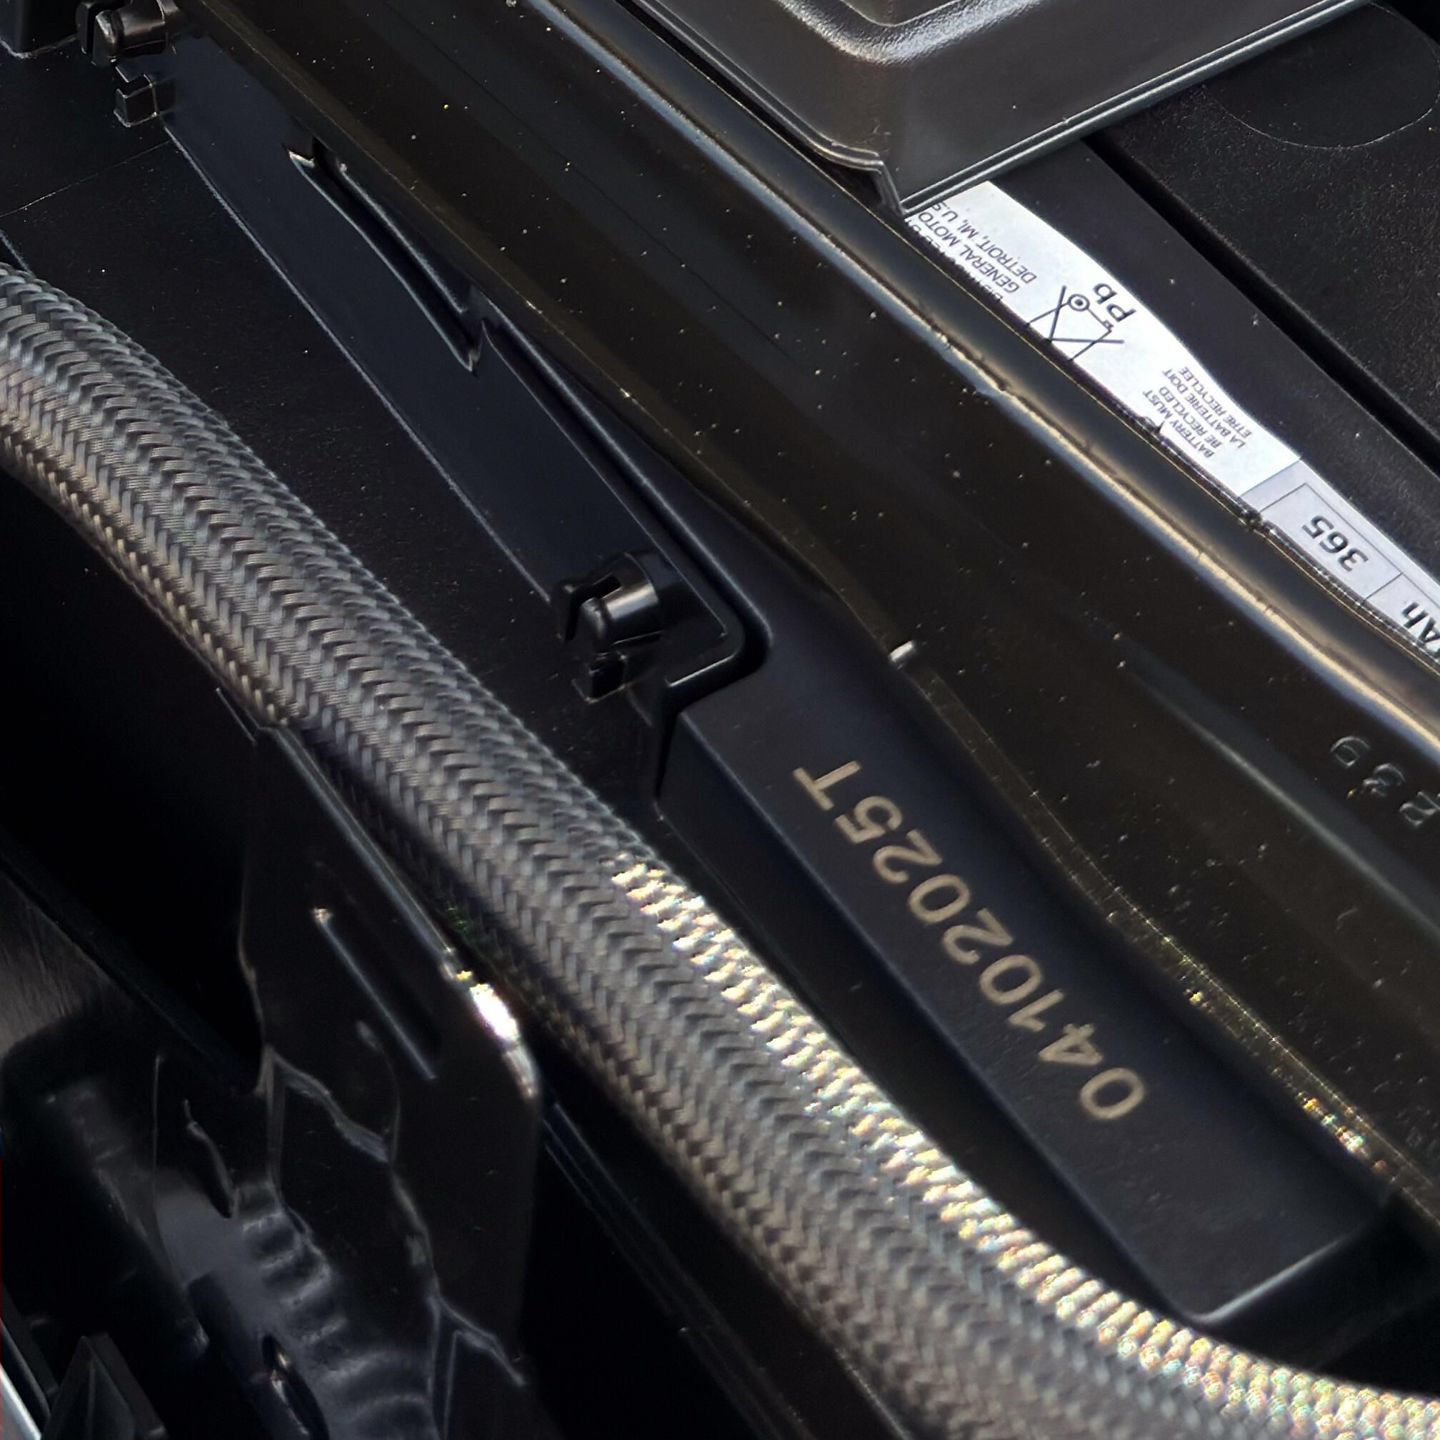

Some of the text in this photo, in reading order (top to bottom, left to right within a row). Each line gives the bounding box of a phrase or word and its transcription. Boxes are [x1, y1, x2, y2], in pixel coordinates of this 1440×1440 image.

[956, 220, 979, 239] MI,
[957, 245, 1021, 294] GENERAL
[976, 236, 1037, 285] DETROIT,
[1093, 282, 1136, 323] Pb
[1157, 386, 1222, 449] BE RECYCLED
[1161, 367, 1246, 449] LA BATTERIE DOIT
[1178, 366, 1228, 417] RECYCLEE
[1141, 388, 1215, 459] BATTERY MUST
[1299, 512, 1370, 572] 365
[793, 760, 1147, 1120] 04102025T
